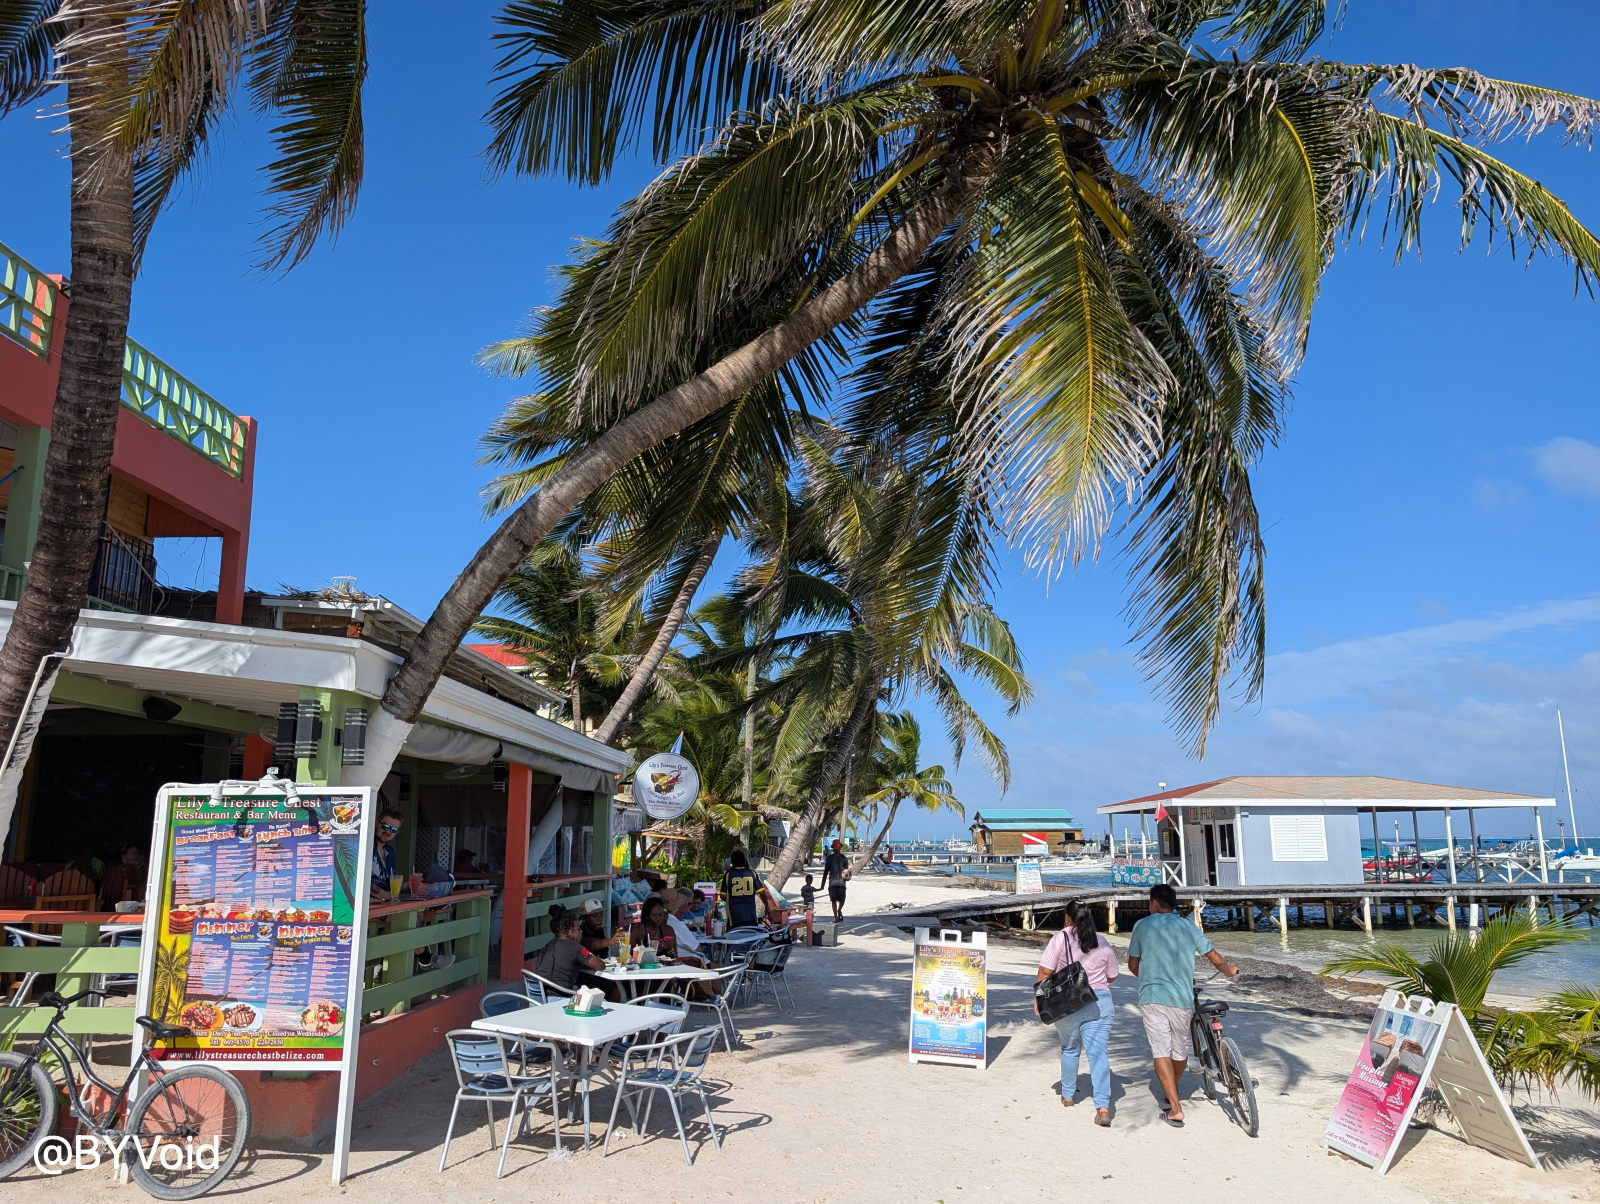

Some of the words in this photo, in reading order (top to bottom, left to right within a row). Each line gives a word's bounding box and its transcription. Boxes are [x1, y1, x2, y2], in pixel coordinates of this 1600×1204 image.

[222, 796, 279, 808] Treasure
[175, 810, 230, 819] Restaurant
[233, 811, 242, 819] &
[247, 810, 264, 819] Bar
[267, 810, 297, 819] Menu
[731, 876, 754, 896] 20
[168, 1050, 325, 1060] www.lilystreasurechestbelize.com
[1356, 1060, 1385, 1077] Couples
[1357, 1071, 1388, 1089] Massage
